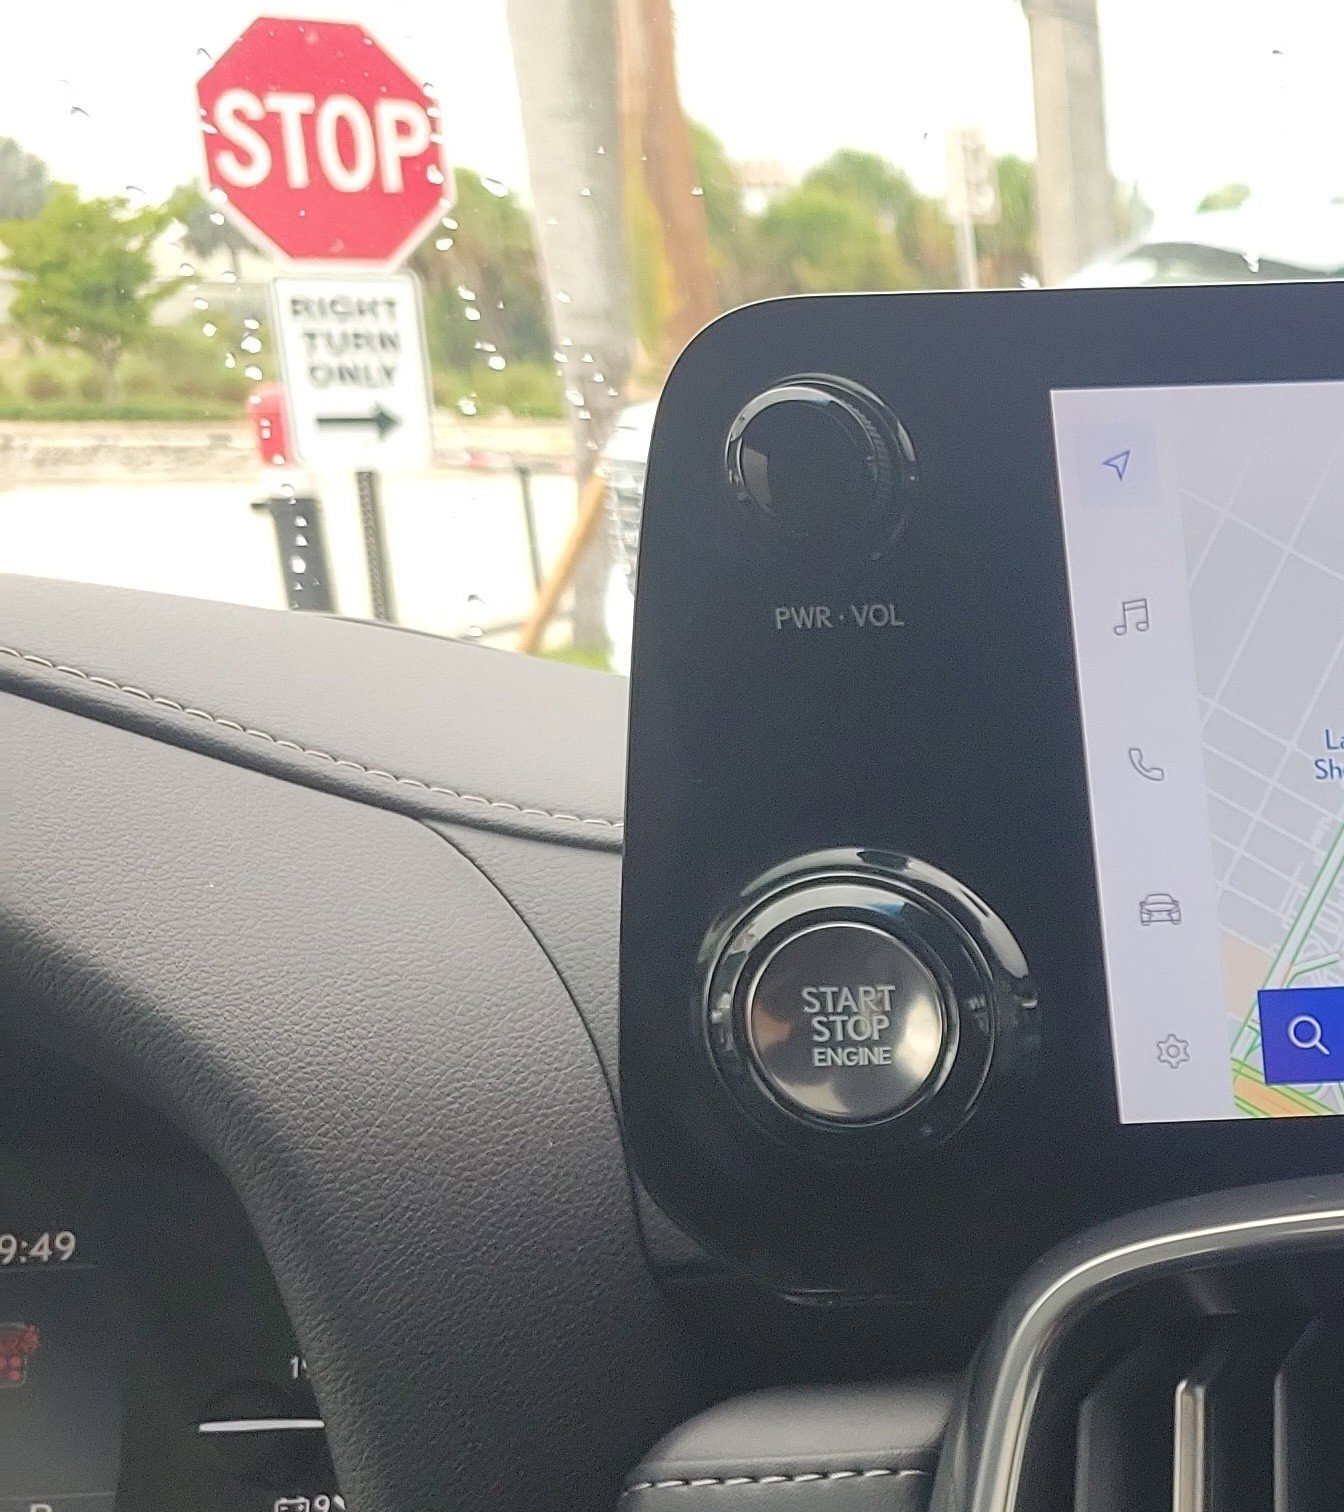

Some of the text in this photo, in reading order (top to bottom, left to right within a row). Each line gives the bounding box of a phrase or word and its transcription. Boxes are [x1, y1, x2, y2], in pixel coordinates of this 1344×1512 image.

[213, 90, 430, 193] STOP
[290, 297, 396, 319] RIGHT
[303, 330, 400, 354] TURN
[308, 362, 396, 388] ONLY
[775, 604, 905, 630] PWR VOL
[802, 985, 896, 1014] START
[811, 1015, 890, 1043] STOP
[814, 1047, 893, 1067] ENGINE
[0, 1231, 75, 1264] 9:49
